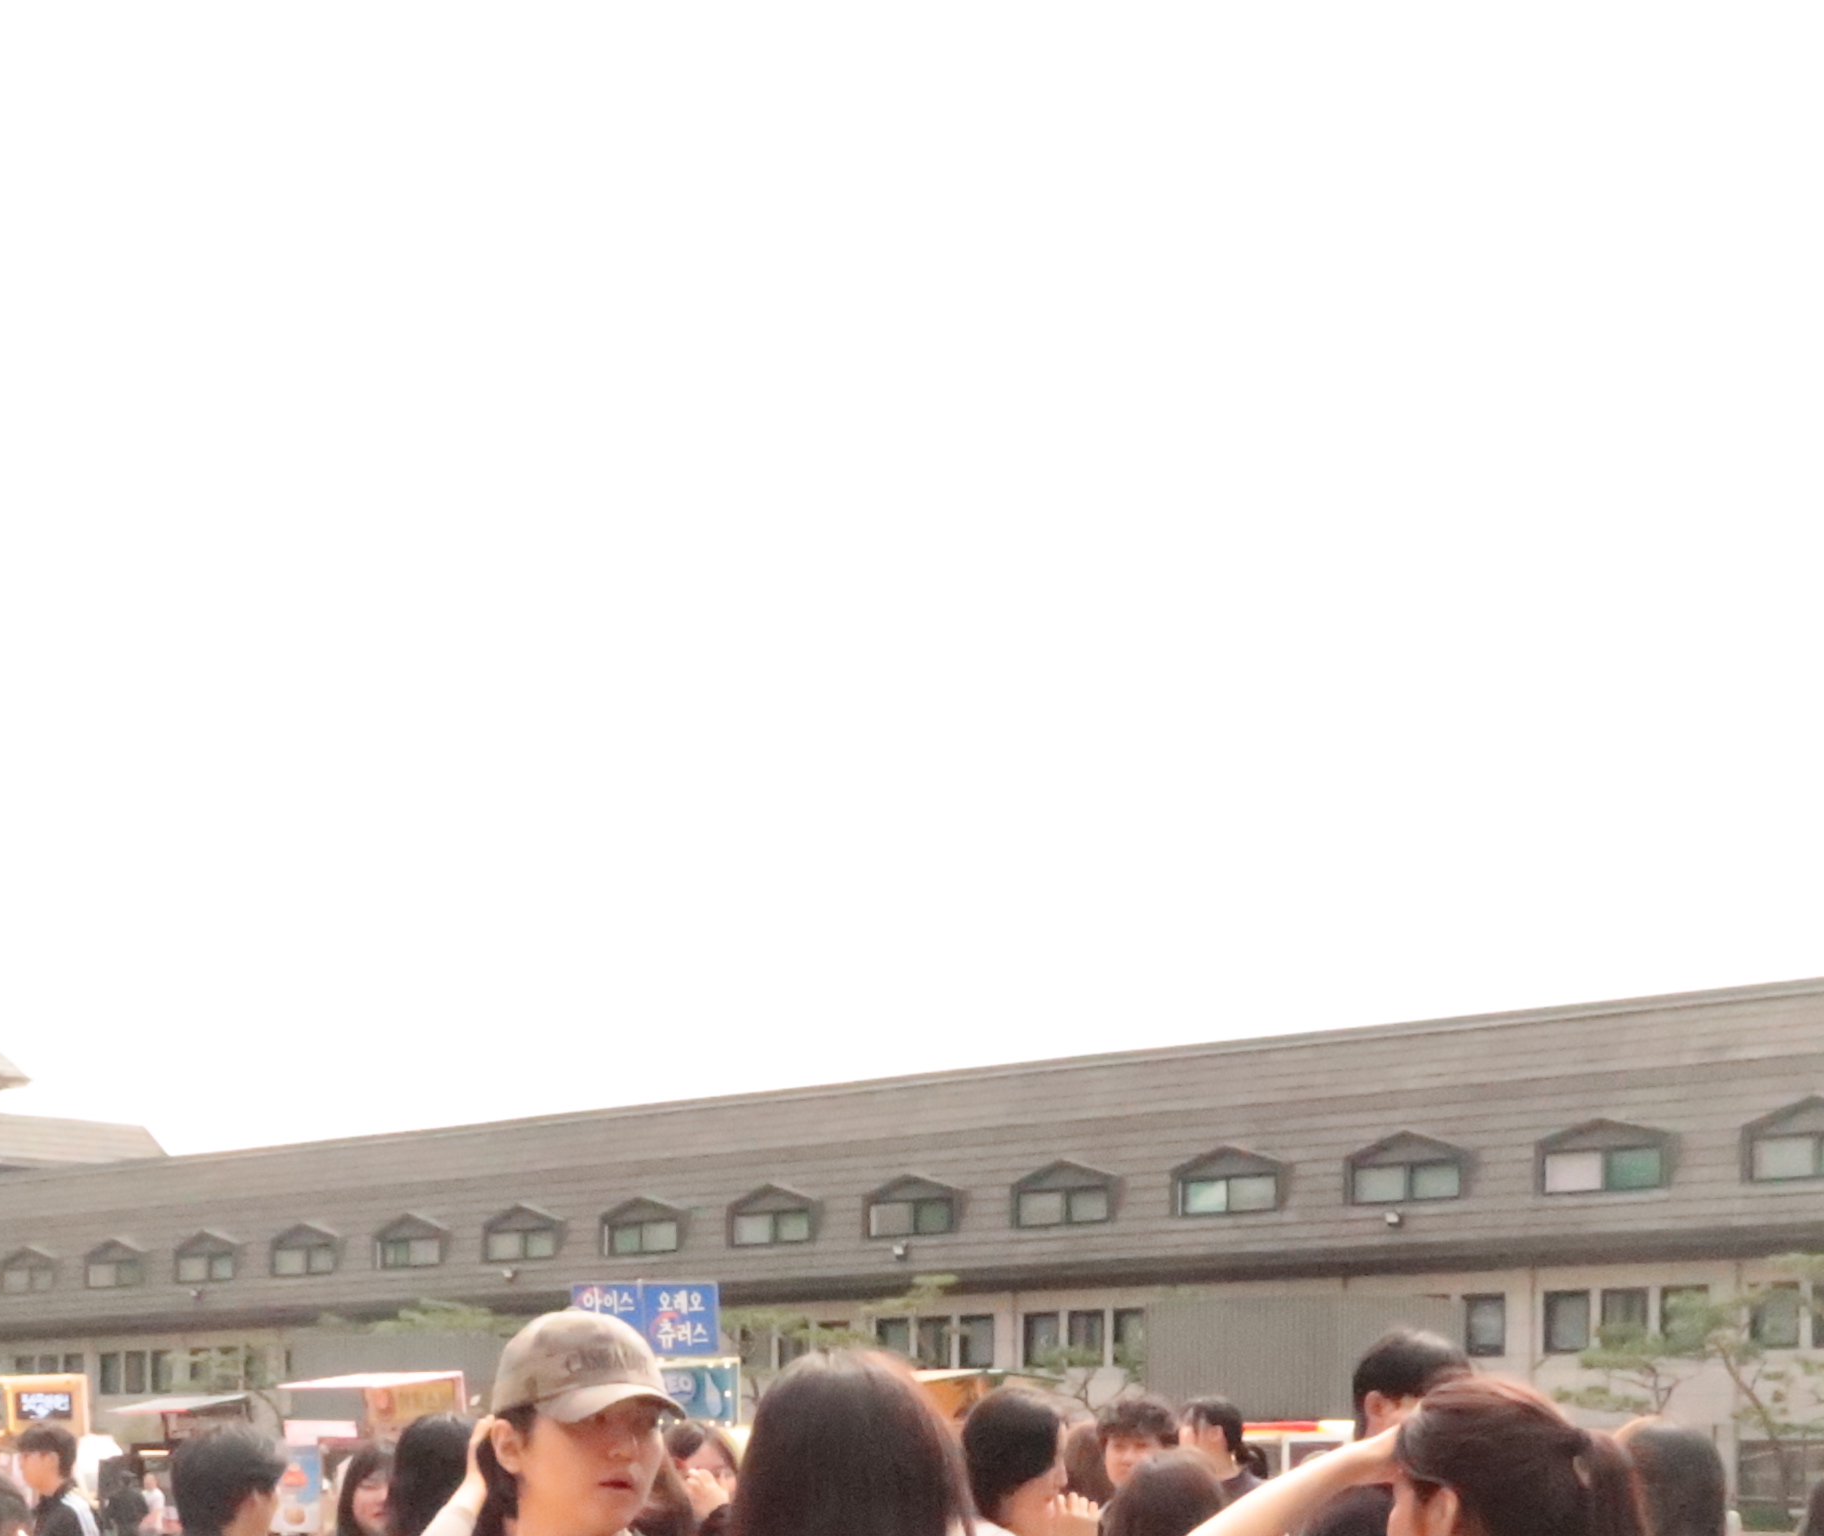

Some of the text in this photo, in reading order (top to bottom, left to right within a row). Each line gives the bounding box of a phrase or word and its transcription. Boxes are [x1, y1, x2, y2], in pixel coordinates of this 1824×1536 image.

[582, 1287, 635, 1314] 아이스
[658, 1289, 705, 1315] 오레오
[656, 1318, 709, 1349] 츄러스
